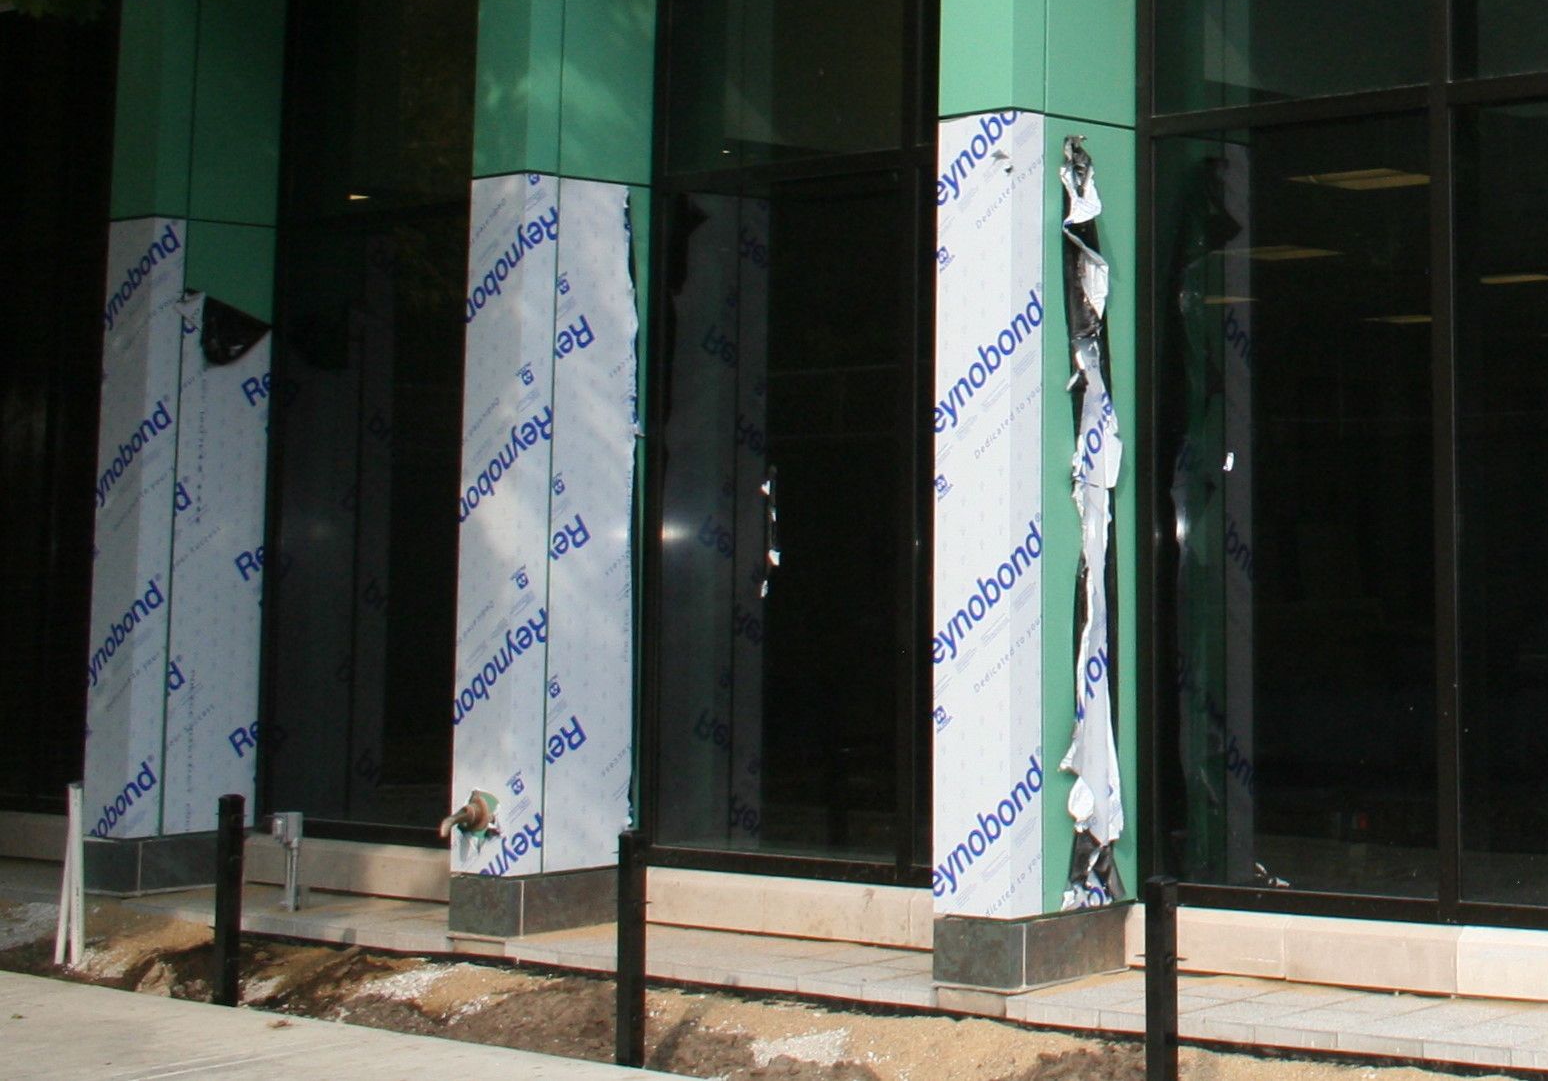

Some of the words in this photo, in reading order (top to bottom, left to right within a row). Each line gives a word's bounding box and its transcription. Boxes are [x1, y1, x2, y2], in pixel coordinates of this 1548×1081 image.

[554, 314, 595, 359] Re
[549, 513, 591, 561] Re
[544, 715, 587, 764] Re
